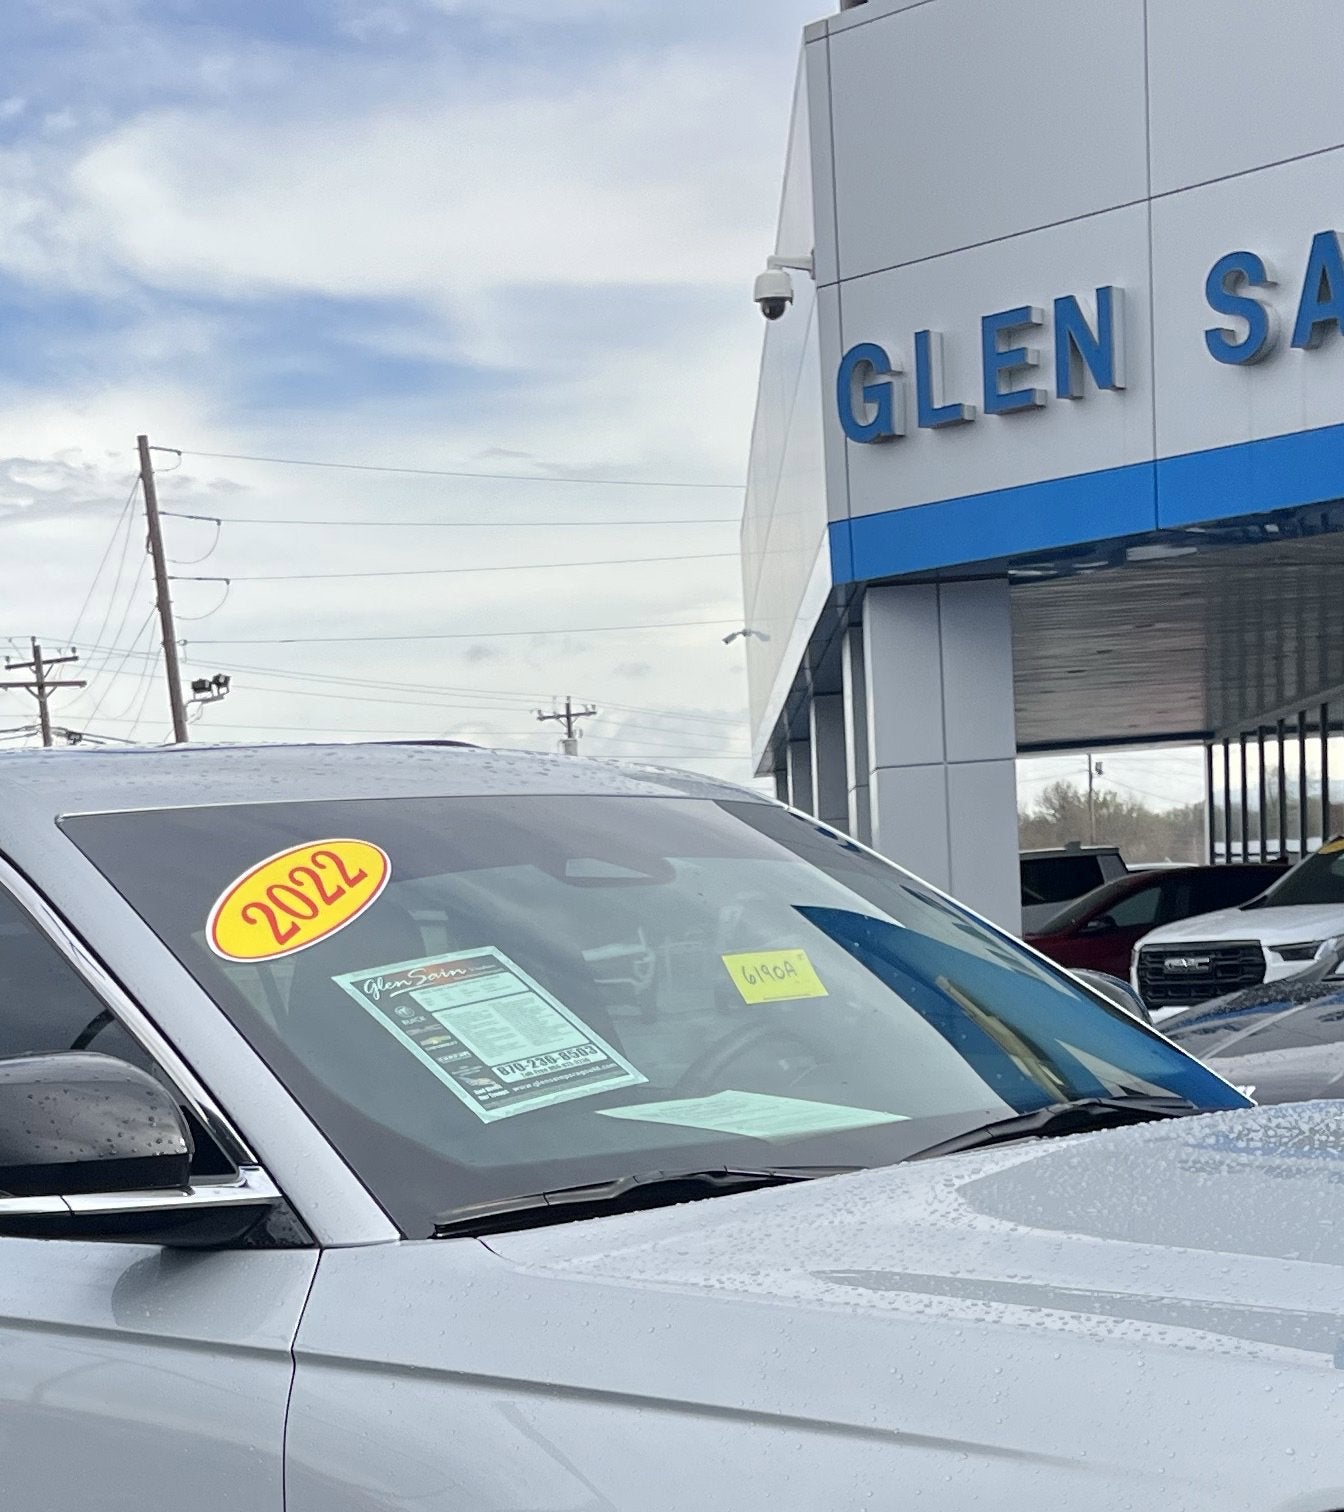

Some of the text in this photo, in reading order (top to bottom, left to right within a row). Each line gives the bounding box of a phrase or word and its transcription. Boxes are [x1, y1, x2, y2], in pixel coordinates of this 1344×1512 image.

[836, 286, 1126, 444] GLEN
[241, 850, 368, 945] 2022
[364, 976, 413, 1000] Glen
[408, 967, 466, 985] Sain
